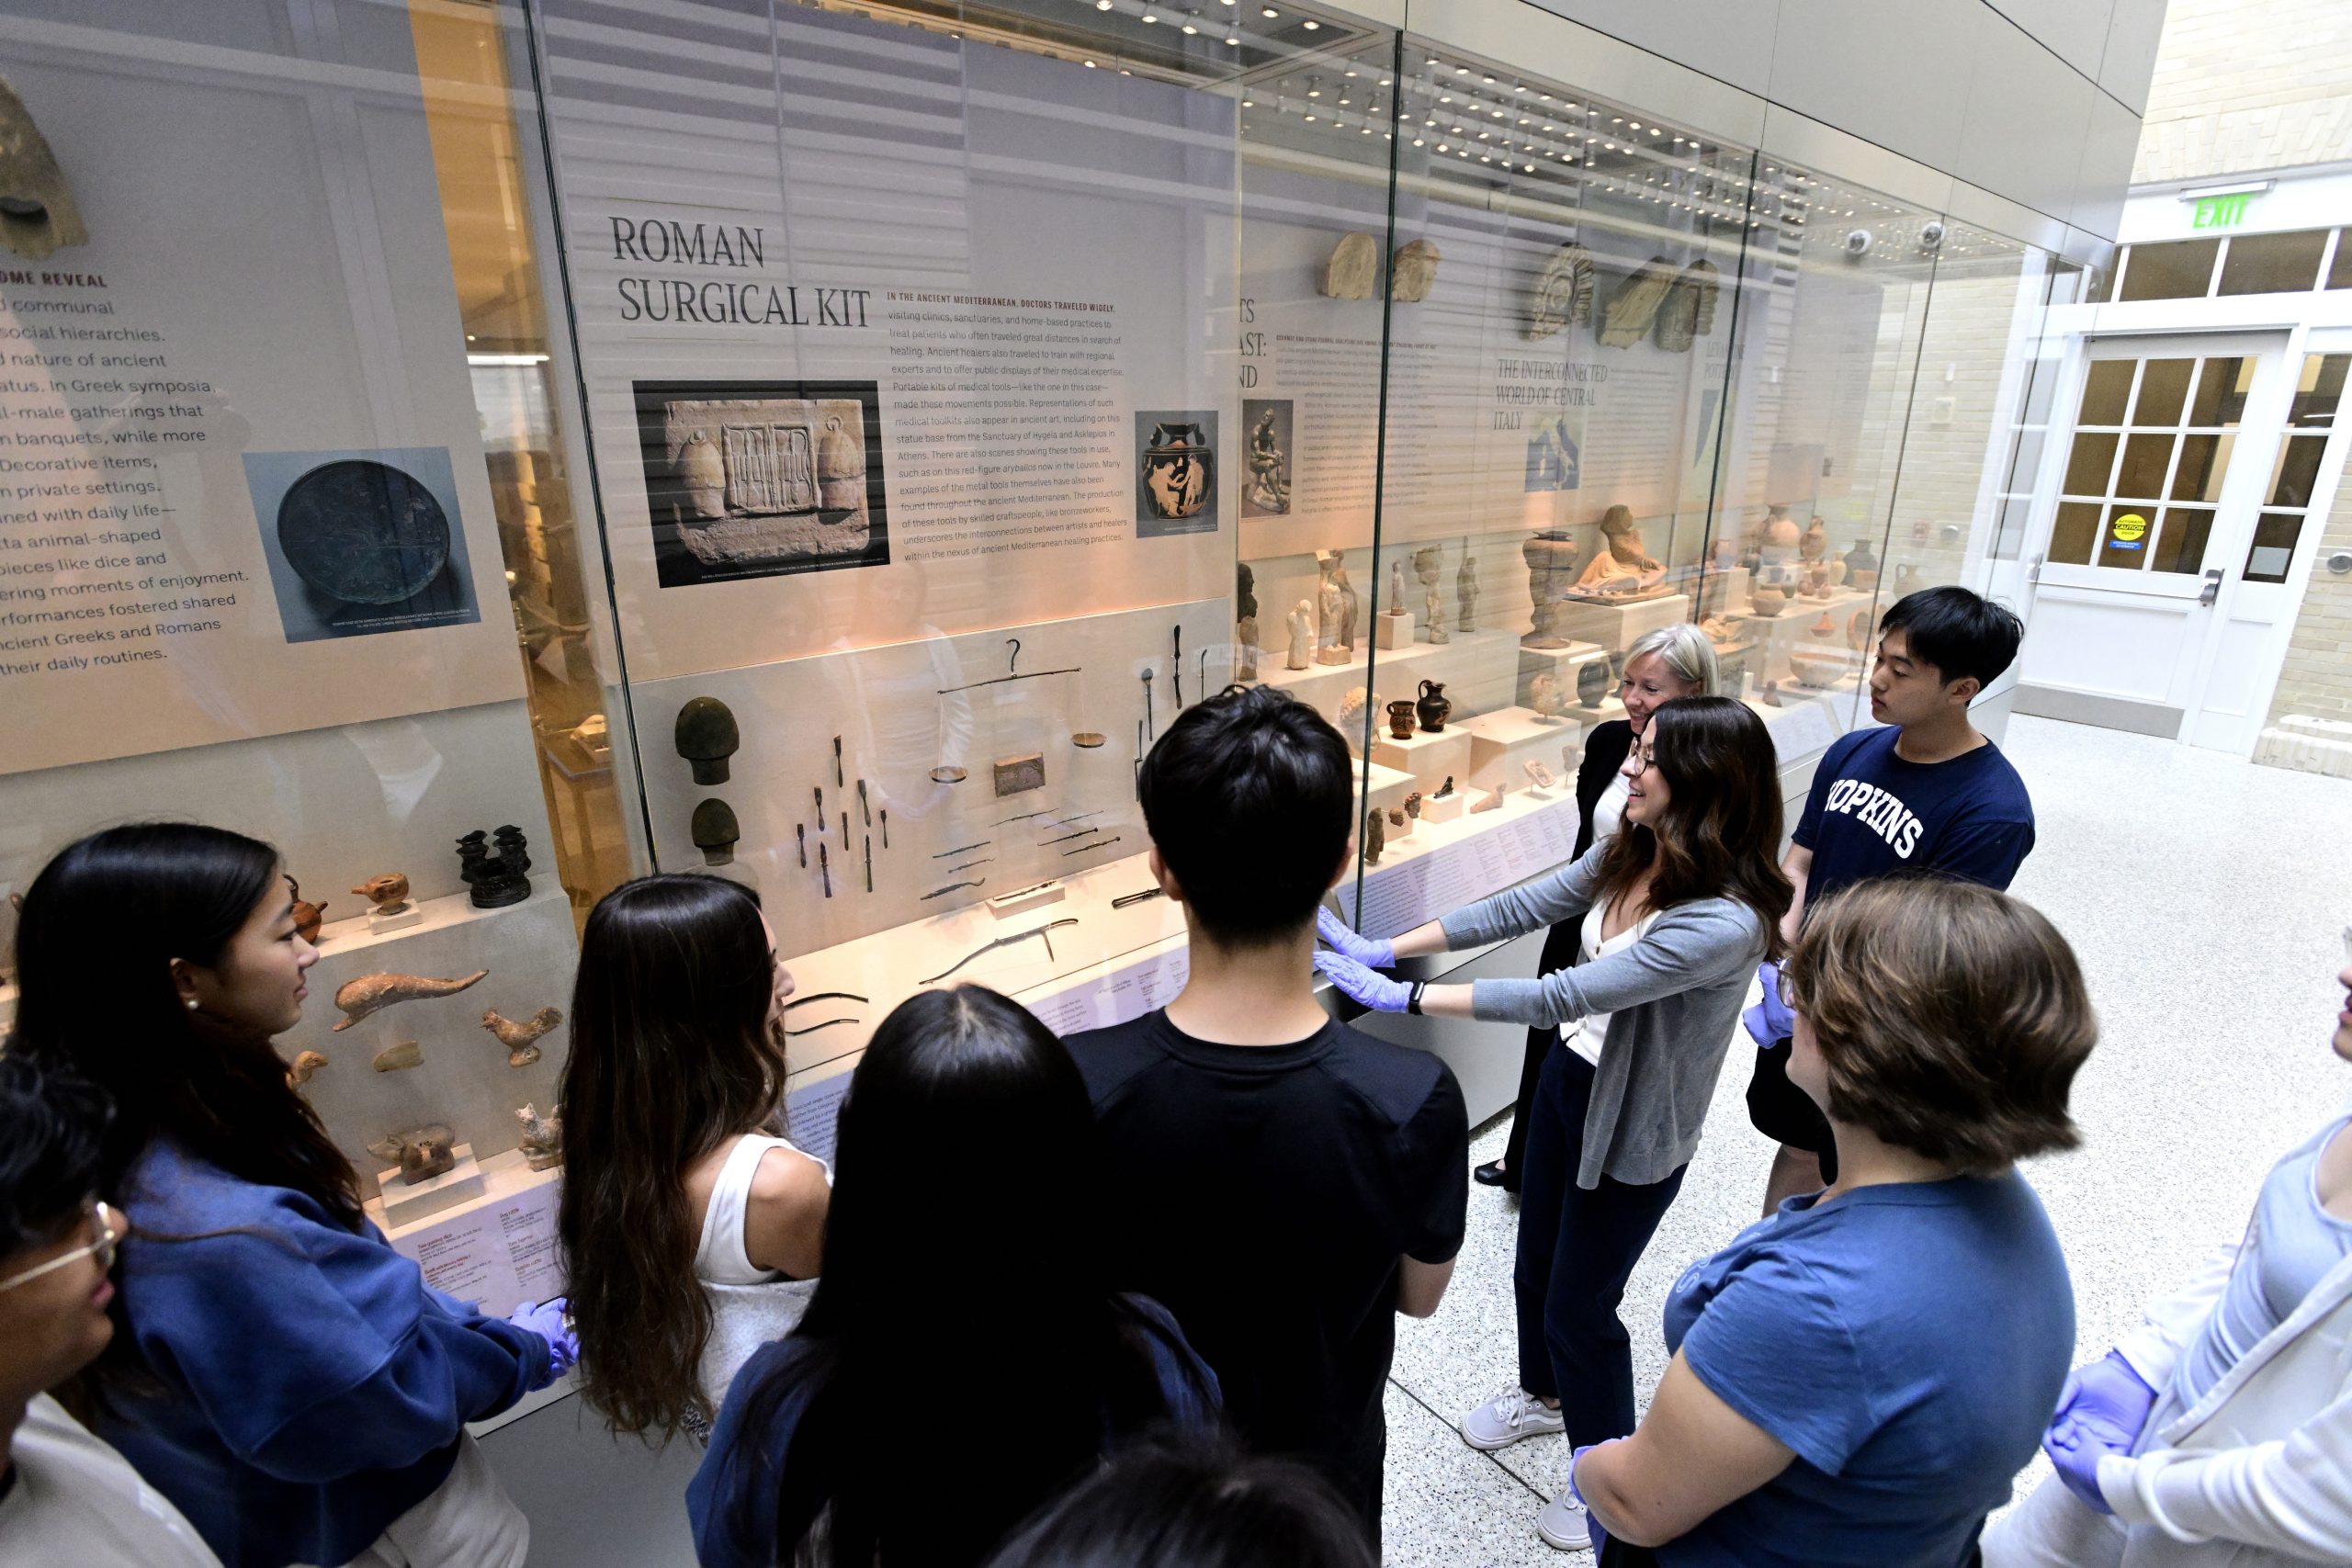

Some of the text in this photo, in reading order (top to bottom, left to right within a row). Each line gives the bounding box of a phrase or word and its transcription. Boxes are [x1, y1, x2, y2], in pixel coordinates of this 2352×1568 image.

[2193, 194, 2250, 228] EXIT
[608, 216, 763, 267] ROMAN
[42, 273, 107, 288] REVEAL
[13, 299, 115, 315] communal
[617, 277, 871, 327] SURGICAL KIT
[887, 292, 897, 301] IN
[899, 293, 914, 302] THE
[917, 294, 951, 304] ANCIENT
[1021, 299, 1052, 310] DOCTORS
[1054, 301, 1087, 311] TRAVELED
[1090, 303, 1115, 313] WIDELY,
[0, 326, 166, 343] social hierarchies.
[11, 355, 73, 367] nature
[78, 353, 96, 367] of
[101, 355, 166, 367] ancient
[890, 346, 1114, 362] healing. Ancient healers also traveled to train with regional
[1498, 359, 1608, 382] THE INTERCONNECTED
[50, 379, 66, 392] In
[72, 379, 124, 393] Greek
[129, 380, 217, 396] symposia,
[893, 382, 929, 391] Portable
[931, 382, 945, 391] kits
[947, 382, 956, 391] of
[957, 382, 990, 391] medical
[1034, 382, 1046, 391] the
[1062, 382, 1069, 391] in
[1070, 382, 1084, 391] this
[1497, 385, 1535, 405] WORLD
[1537, 387, 1552, 405] OF
[1554, 388, 1595, 406] CENTRAL
[71, 405, 165, 422] gatherings
[169, 404, 204, 417] that
[894, 399, 1114, 410] made these movements possible. Representations of such
[1494, 411, 1523, 430] ITALY
[17, 433, 108, 446] banquets,
[113, 432, 158, 443] while
[163, 430, 206, 443] more
[898, 451, 930, 461] Athens.
[932, 451, 954, 459] There
[956, 450, 968, 458] are
[970, 449, 987, 457] also
[988, 449, 1014, 457] scenes
[1016, 447, 1046, 457] showing
[1048, 446, 1068, 455] these
[1069, 446, 1087, 455] tools
[1097, 446, 1111, 454] use,
[0, 456, 158, 473] Decorative items,
[899, 468, 919, 478] such
[921, 468, 931, 477] as
[944, 467, 960, 476] this
[961, 465, 1001, 475] red-figure
[1037, 463, 1053, 471] now
[1055, 462, 1061, 470] in
[1102, 460, 1121, 469] Many
[17, 482, 81, 500] private
[85, 479, 162, 495] settings.
[900, 485, 939, 495] examples
[941, 483, 949, 492] of
[951, 483, 964, 491] the
[967, 482, 989, 491] metal
[989, 480, 1009, 490] tools
[1011, 479, 1052, 488] themselves
[1088, 476, 1104, 484] been
[901, 490, 1124, 512] found throughout the ancient Mediterranean. The production
[43, 507, 83, 522] with
[88, 506, 129, 521] daily
[902, 505, 1111, 528] of these tools by skilled craftspeople, like bronzeworkers,
[28, 529, 162, 548] animal-shaped
[903, 518, 1127, 546] underscores the interconnections between artists and healers
[905, 551, 930, 561] within
[932, 549, 944, 558] the
[946, 548, 969, 557] nexus
[971, 547, 979, 555] of
[981, 544, 1009, 553] ancient
[1011, 539, 1063, 551] Mediterranean
[1064, 536, 1090, 546] healing
[59, 558, 89, 571] like
[95, 556, 130, 569] dice
[135, 552, 166, 566] and
[51, 580, 134, 596] moments
[138, 576, 155, 591] of
[159, 570, 250, 591] enjoyment.
[109, 600, 178, 616] fostered
[182, 594, 237, 610] shared
[55, 628, 116, 646] Greeks
[120, 626, 152, 639] and
[155, 619, 222, 636] Romans
[0, 649, 167, 676] their daily routines.
